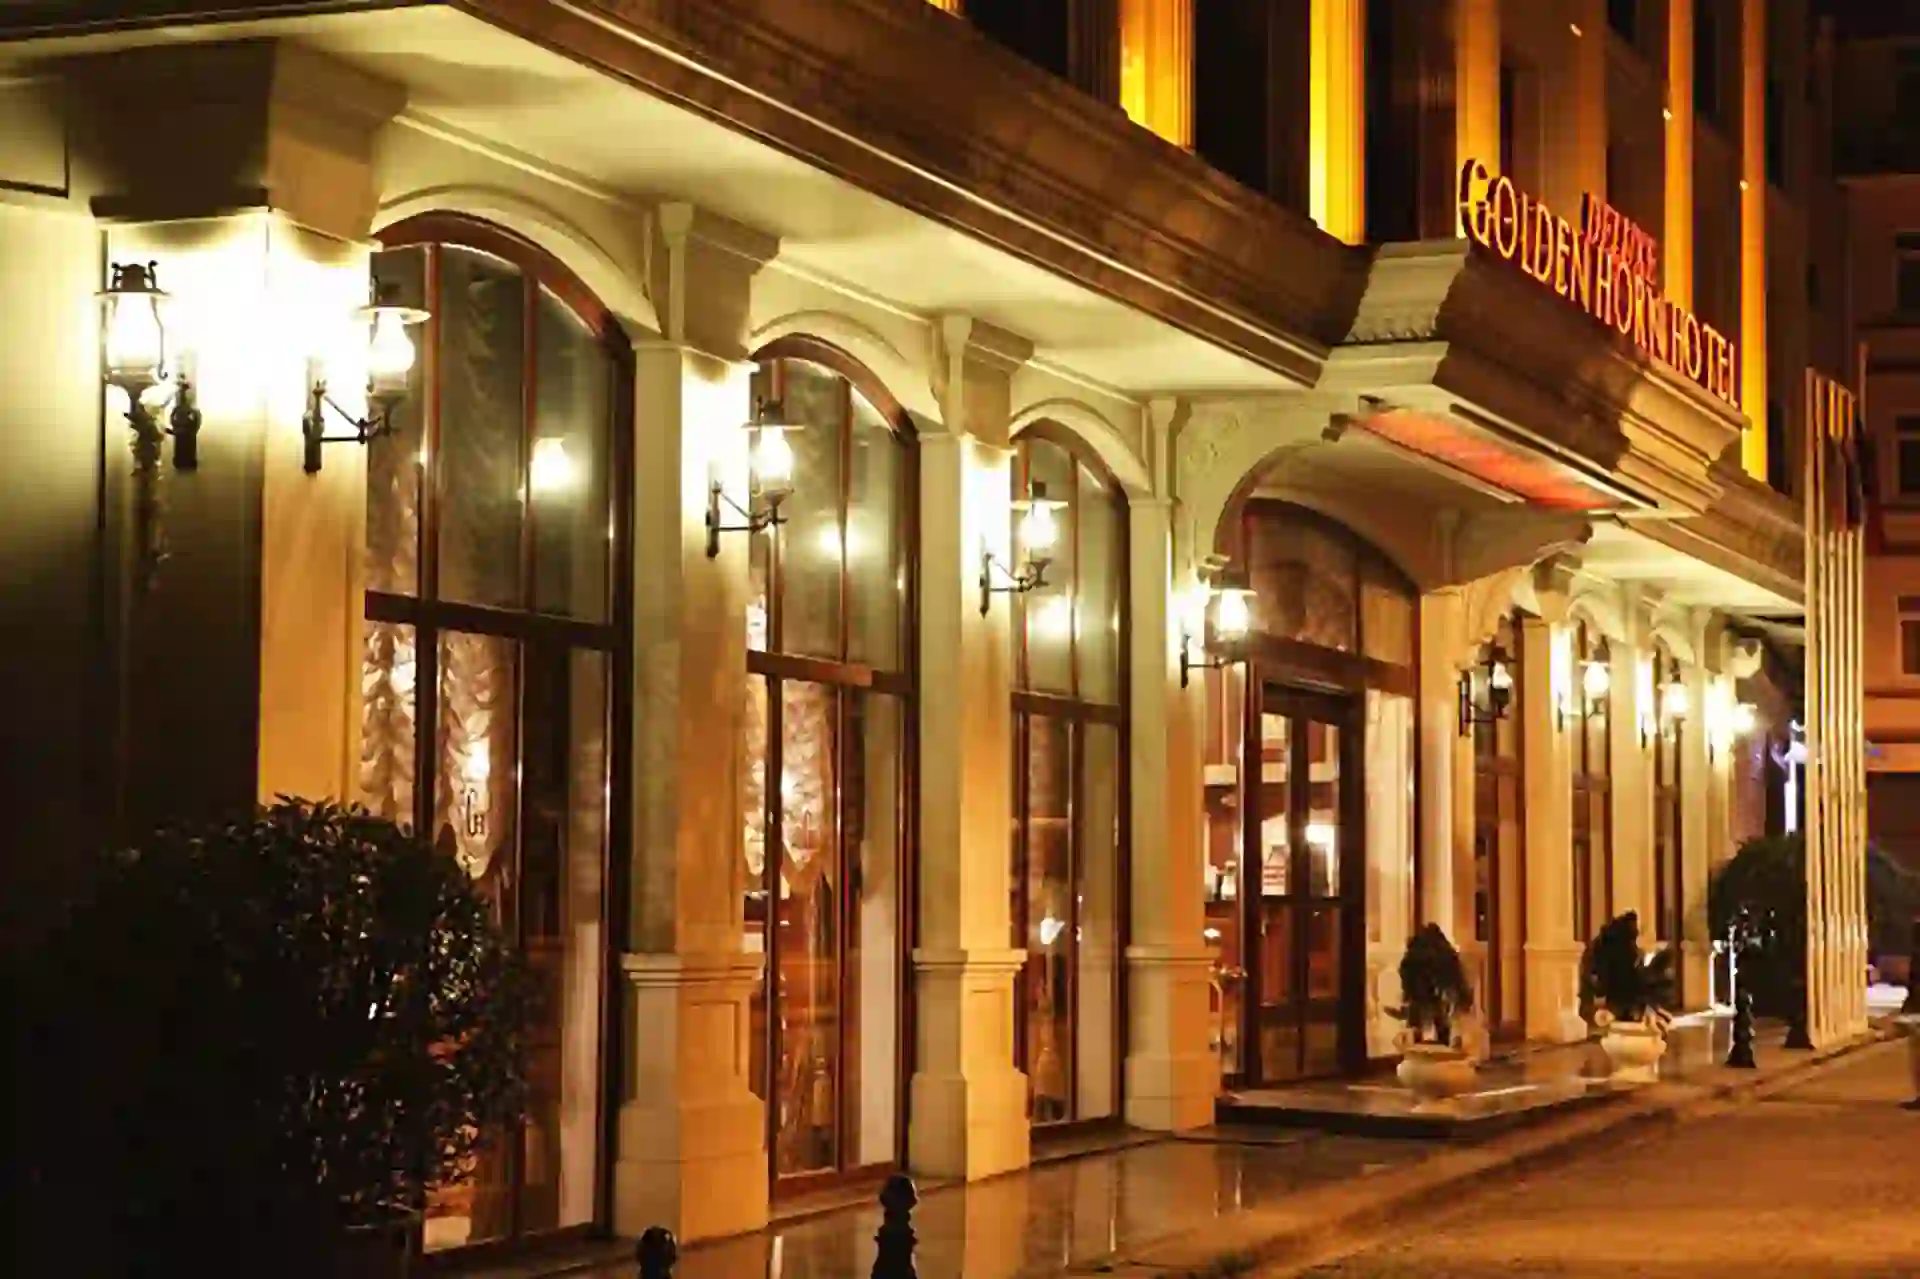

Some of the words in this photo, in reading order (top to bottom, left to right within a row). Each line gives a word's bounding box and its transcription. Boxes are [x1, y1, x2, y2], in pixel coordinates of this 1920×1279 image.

[1460, 158, 1590, 313] GOLDEN
[1594, 247, 1667, 363] HORN
[1671, 304, 1739, 406] HOTEL
